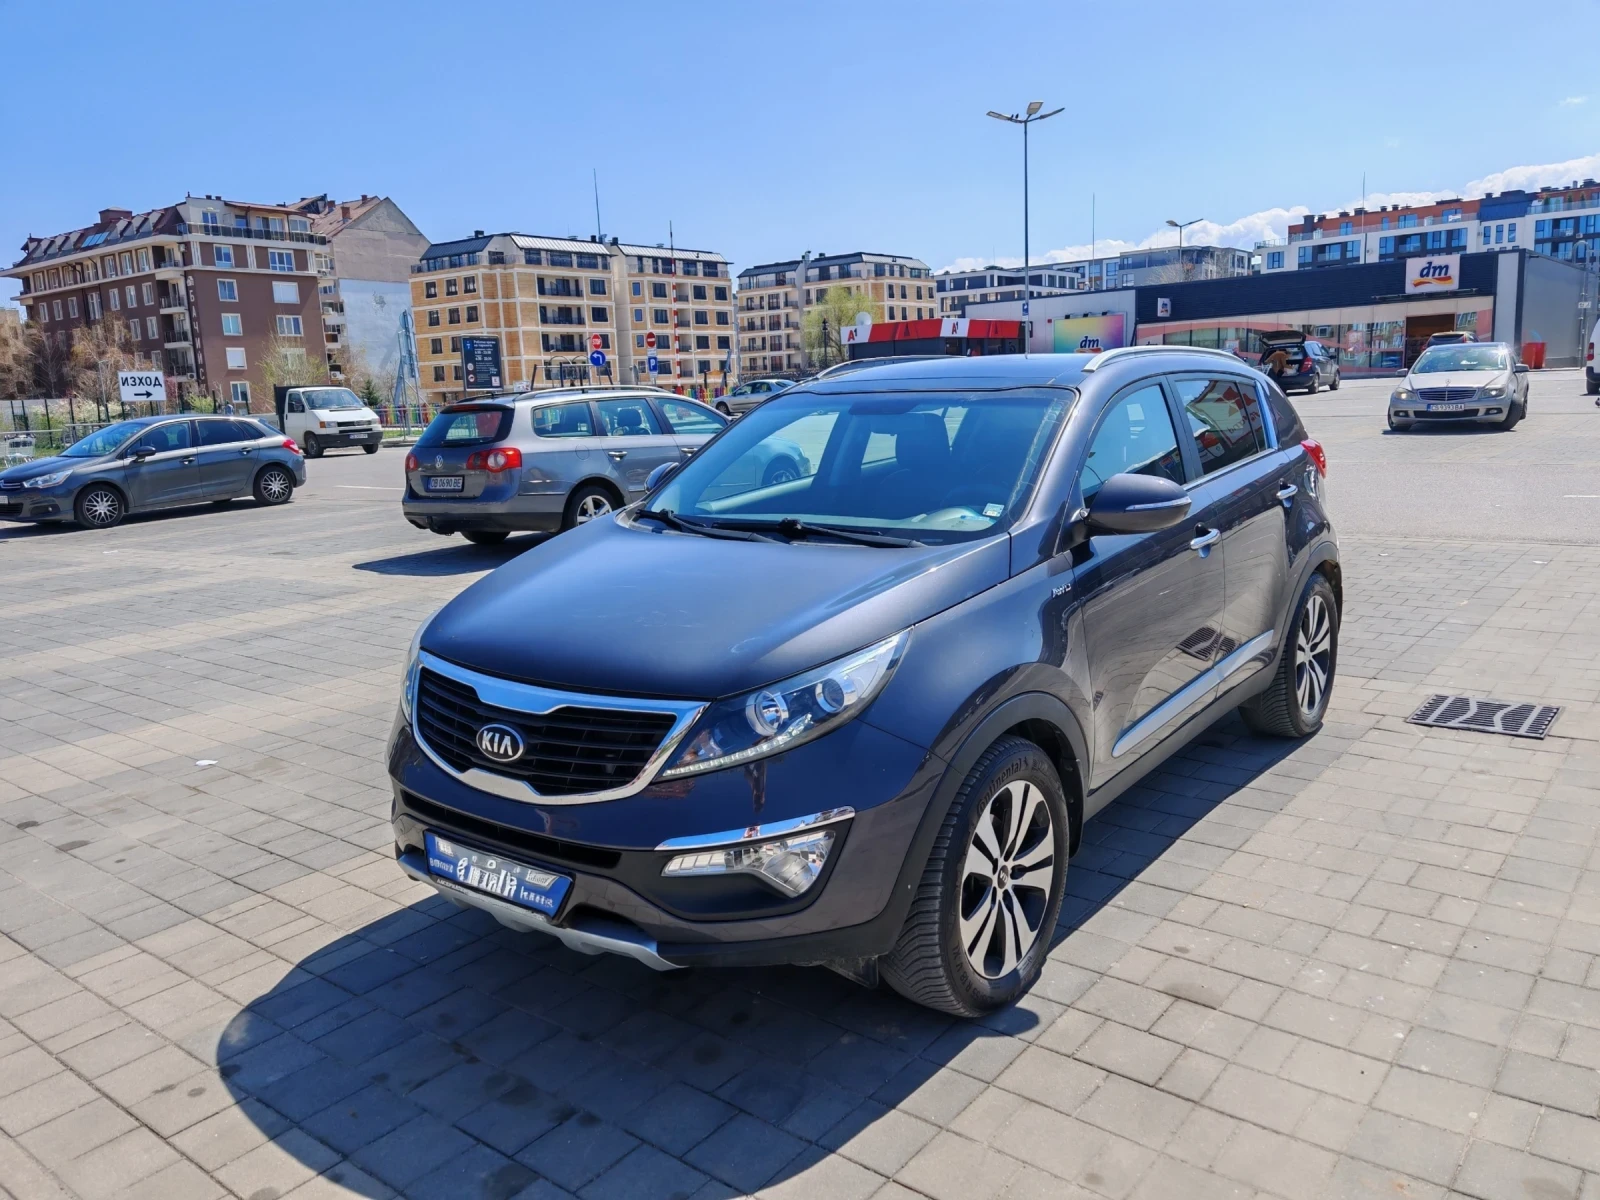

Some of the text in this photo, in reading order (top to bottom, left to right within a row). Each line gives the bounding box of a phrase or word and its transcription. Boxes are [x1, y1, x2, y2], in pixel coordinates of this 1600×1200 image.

[1420, 261, 1449, 278] dm
[847, 327, 858, 342] A1
[951, 321, 959, 335] A1
[1080, 336, 1100, 349] dm
[650, 358, 656, 370] P
[120, 376, 163, 388] ИЗХОД
[481, 729, 514, 757] KIA
